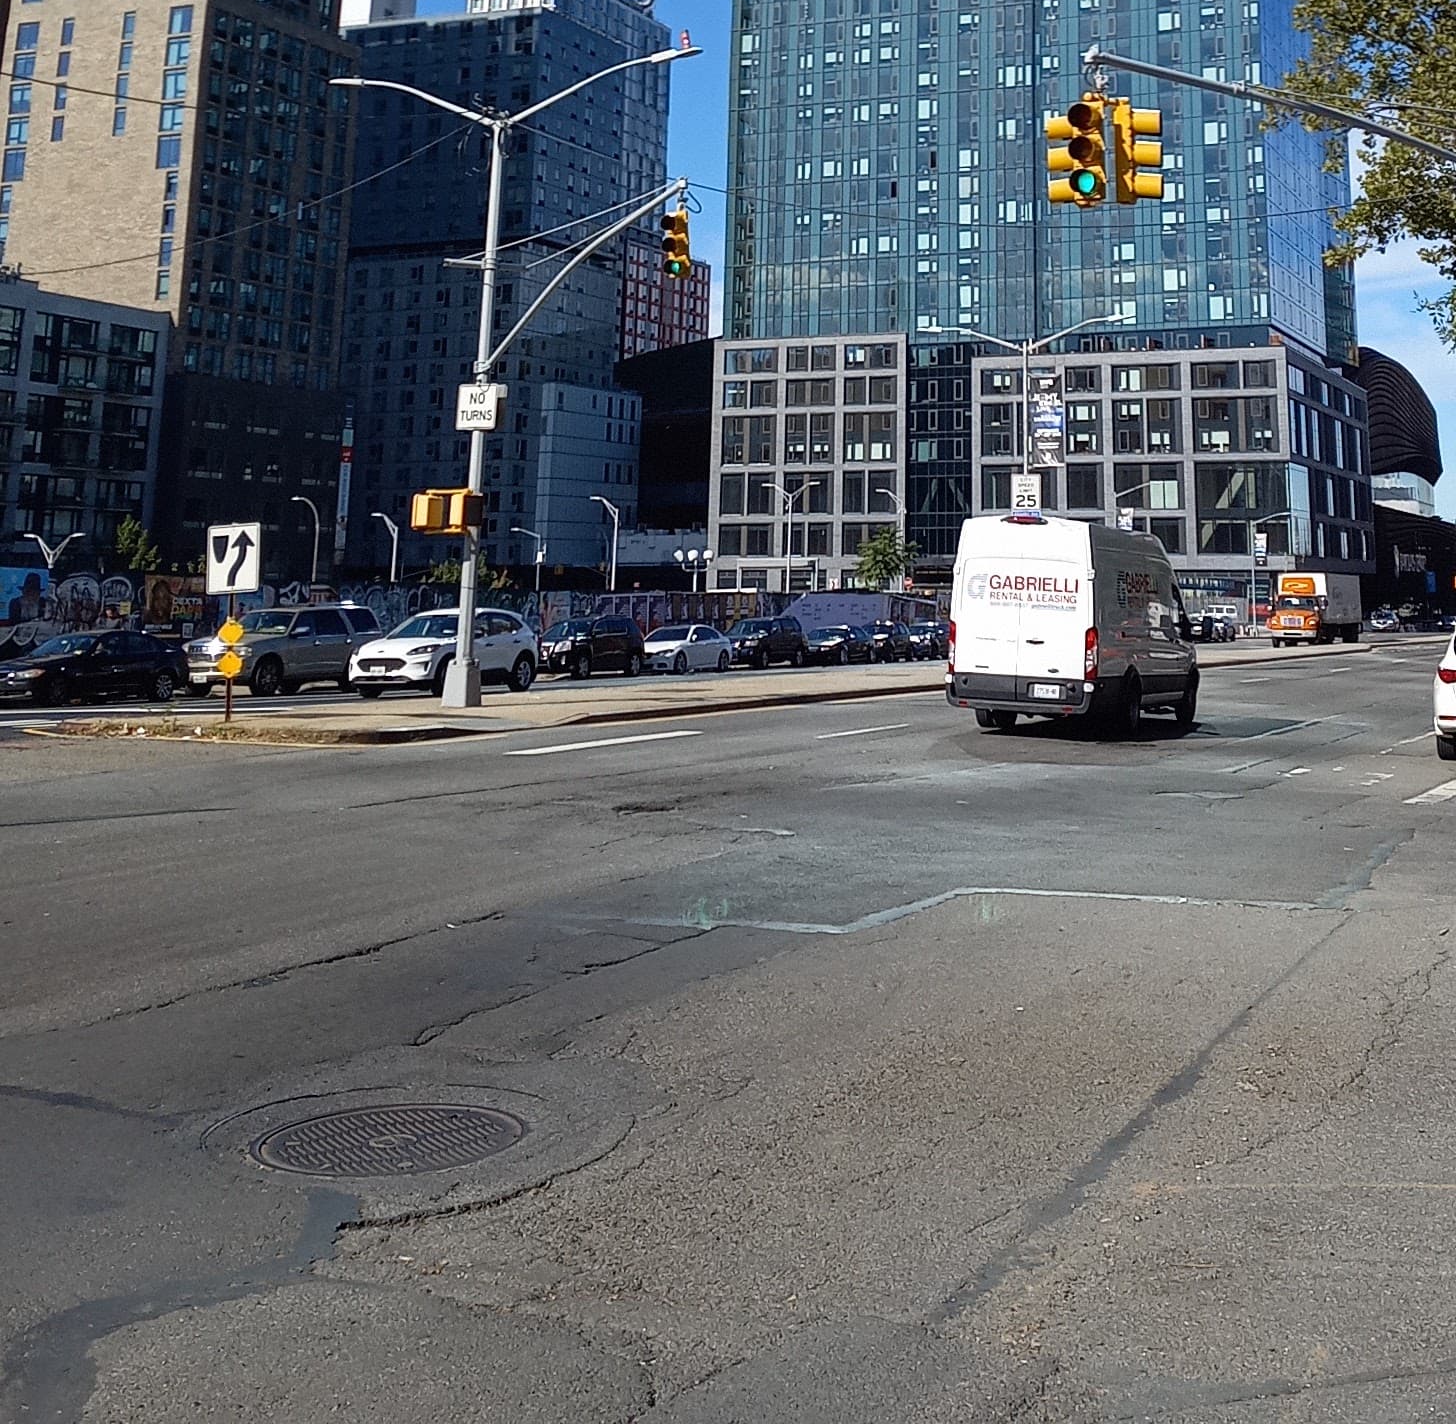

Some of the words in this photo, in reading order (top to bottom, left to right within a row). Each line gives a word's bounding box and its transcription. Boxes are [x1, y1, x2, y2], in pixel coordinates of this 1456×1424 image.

[469, 392, 486, 405] NO
[460, 409, 493, 422] TURNS
[1015, 494, 1037, 508] 25
[989, 574, 1079, 594] GABRIELLI
[989, 591, 1023, 602] RENTAL
[1026, 593, 1033, 602] &
[1036, 593, 1077, 604] LEASING
